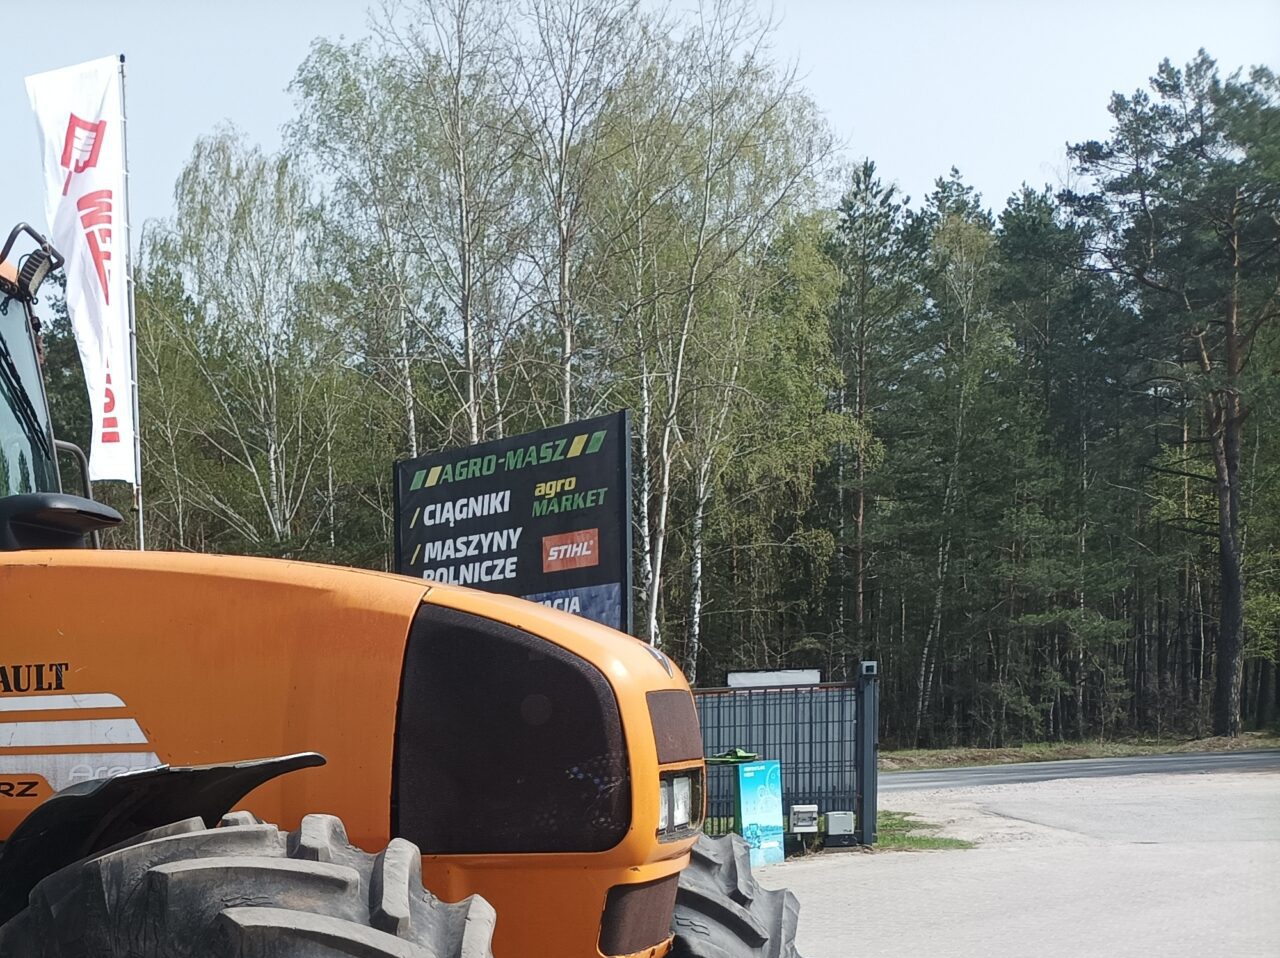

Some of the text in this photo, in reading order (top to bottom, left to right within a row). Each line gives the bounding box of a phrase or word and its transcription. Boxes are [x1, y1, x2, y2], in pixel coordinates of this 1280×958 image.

[439, 438, 568, 485] AGRO-MASZ
[532, 487, 608, 518] MARKET
[534, 477, 576, 499] agro
[423, 490, 511, 527] CIĄGNIKI
[424, 527, 522, 564] MASZYNY
